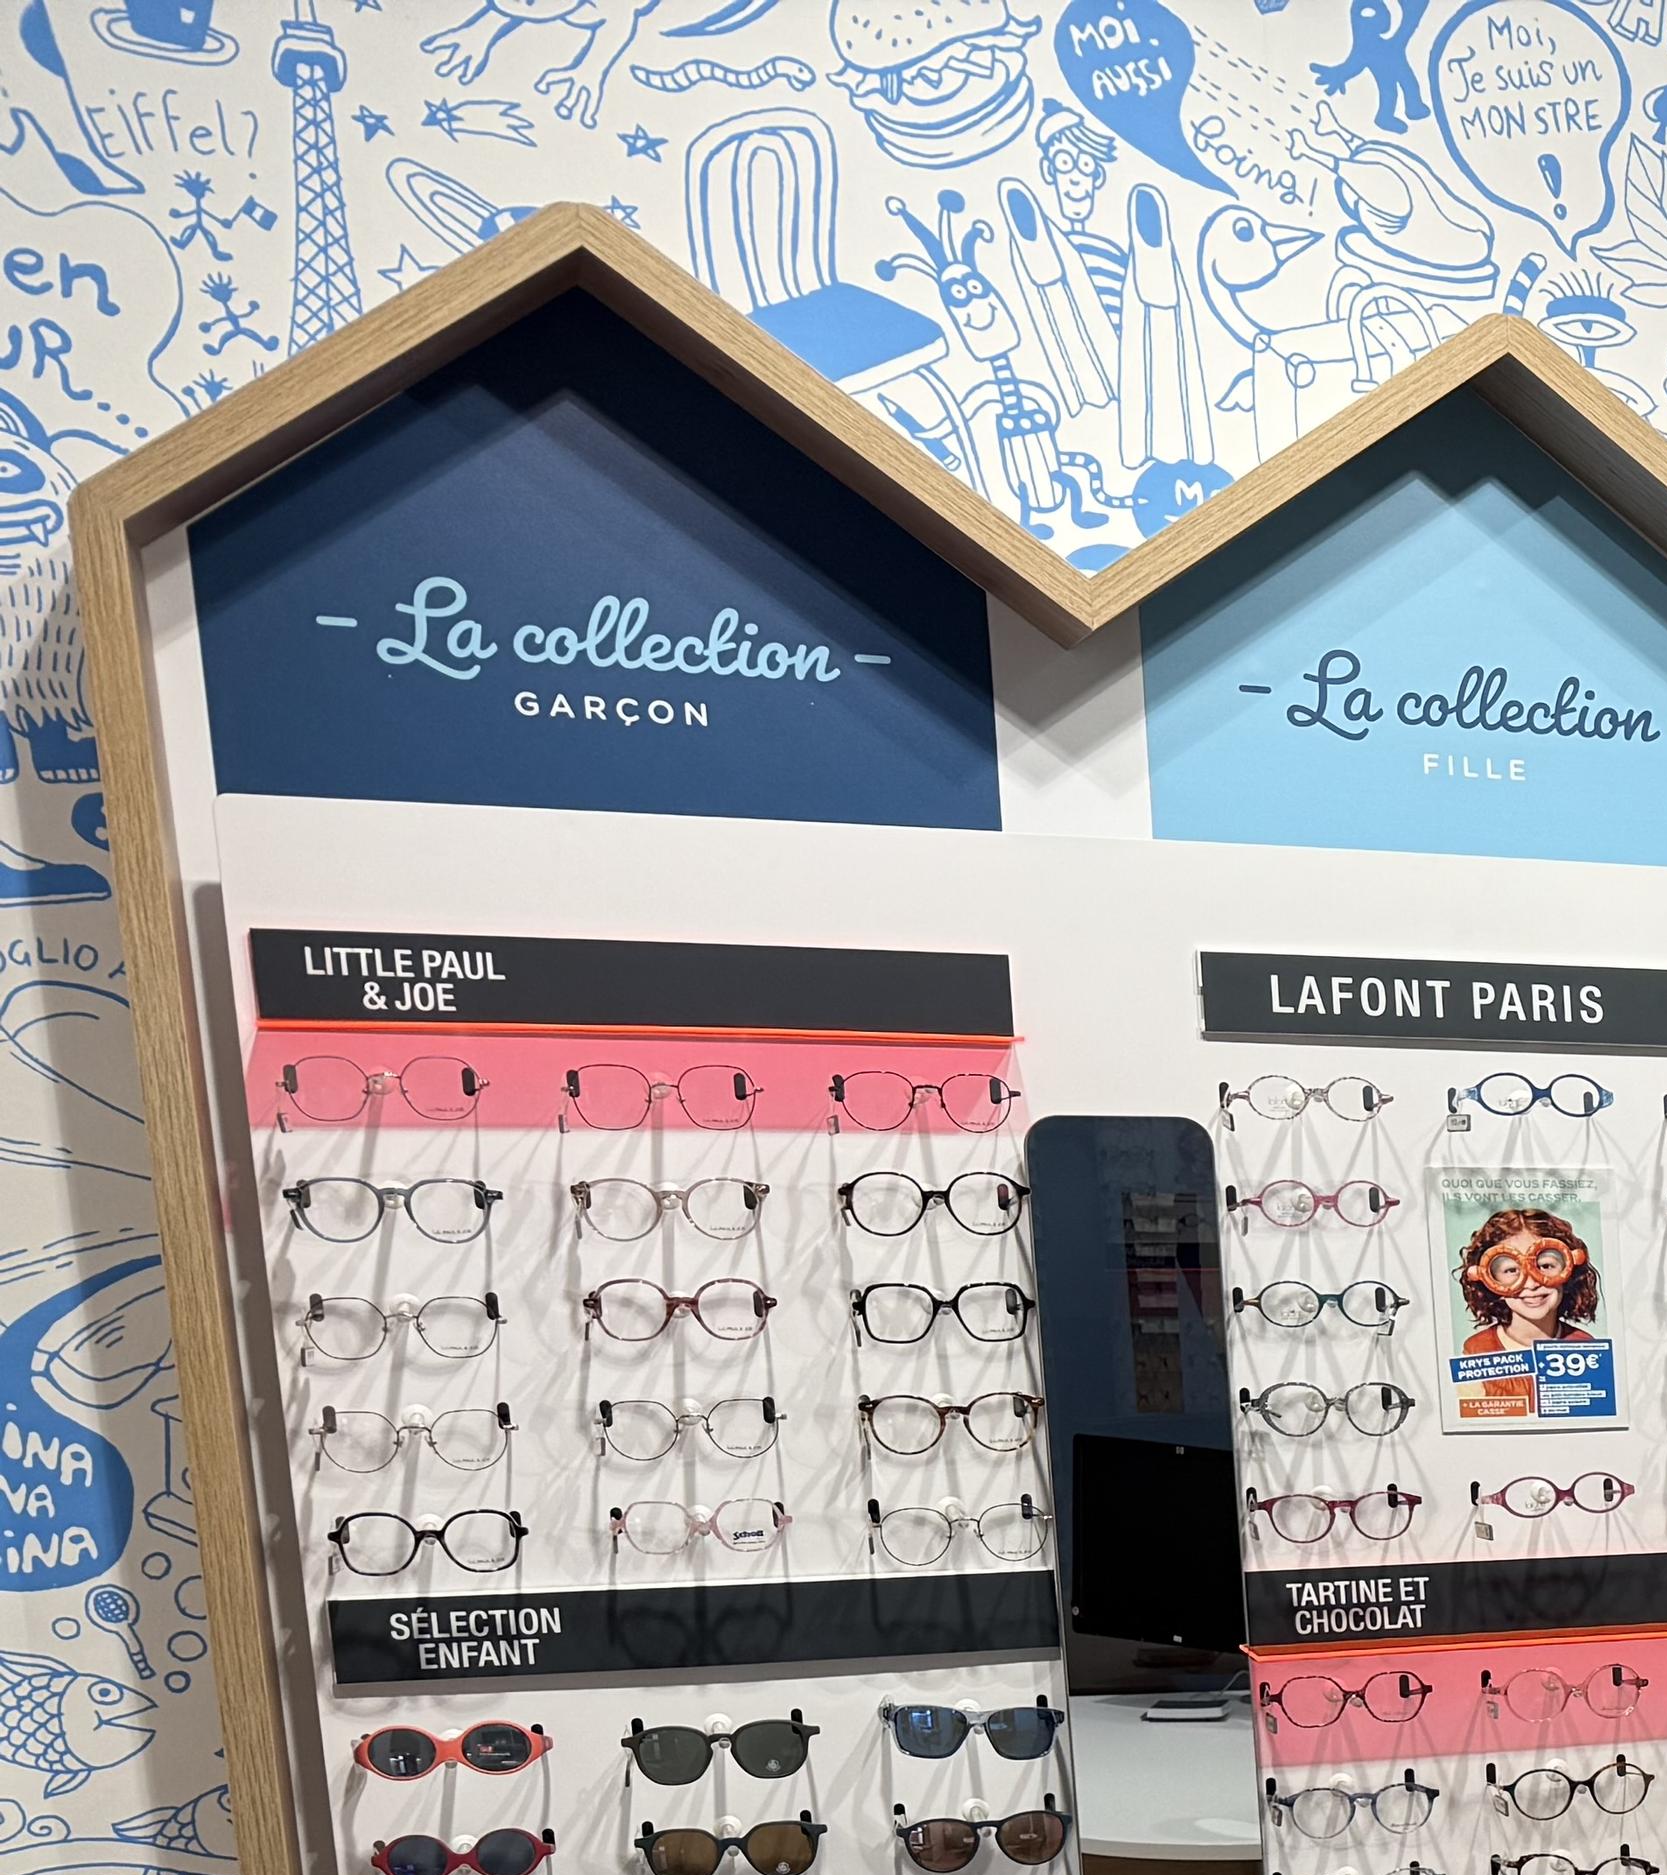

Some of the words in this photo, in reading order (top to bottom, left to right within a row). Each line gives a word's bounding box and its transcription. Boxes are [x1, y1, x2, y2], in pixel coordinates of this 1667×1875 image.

[1090, 56, 1168, 98] AUSSI
[1448, 46, 1486, 102] Je
[1563, 58, 1602, 85] un
[377, 577, 497, 680] La
[513, 595, 841, 684] collection
[514, 691, 710, 729] GARÇON
[1286, 650, 1381, 741] La
[1397, 665, 1660, 744] collection
[1423, 755, 1527, 781] FILLE
[304, 945, 413, 978] LITTLE
[423, 948, 506, 981] PAUL
[362, 981, 388, 1011] &
[394, 982, 457, 1012] JOE
[1269, 973, 1452, 1020] LAFONT
[1472, 981, 1605, 1024] PARIS
[1457, 1363, 1530, 1381] PROTECTION
[1286, 1578, 1394, 1608] TARTINE
[1400, 1576, 1430, 1602] ET
[389, 1604, 562, 1641] SÉLECTION
[1294, 1603, 1426, 1636] CHOCOLAT
[419, 1638, 540, 1669] ENFANT
